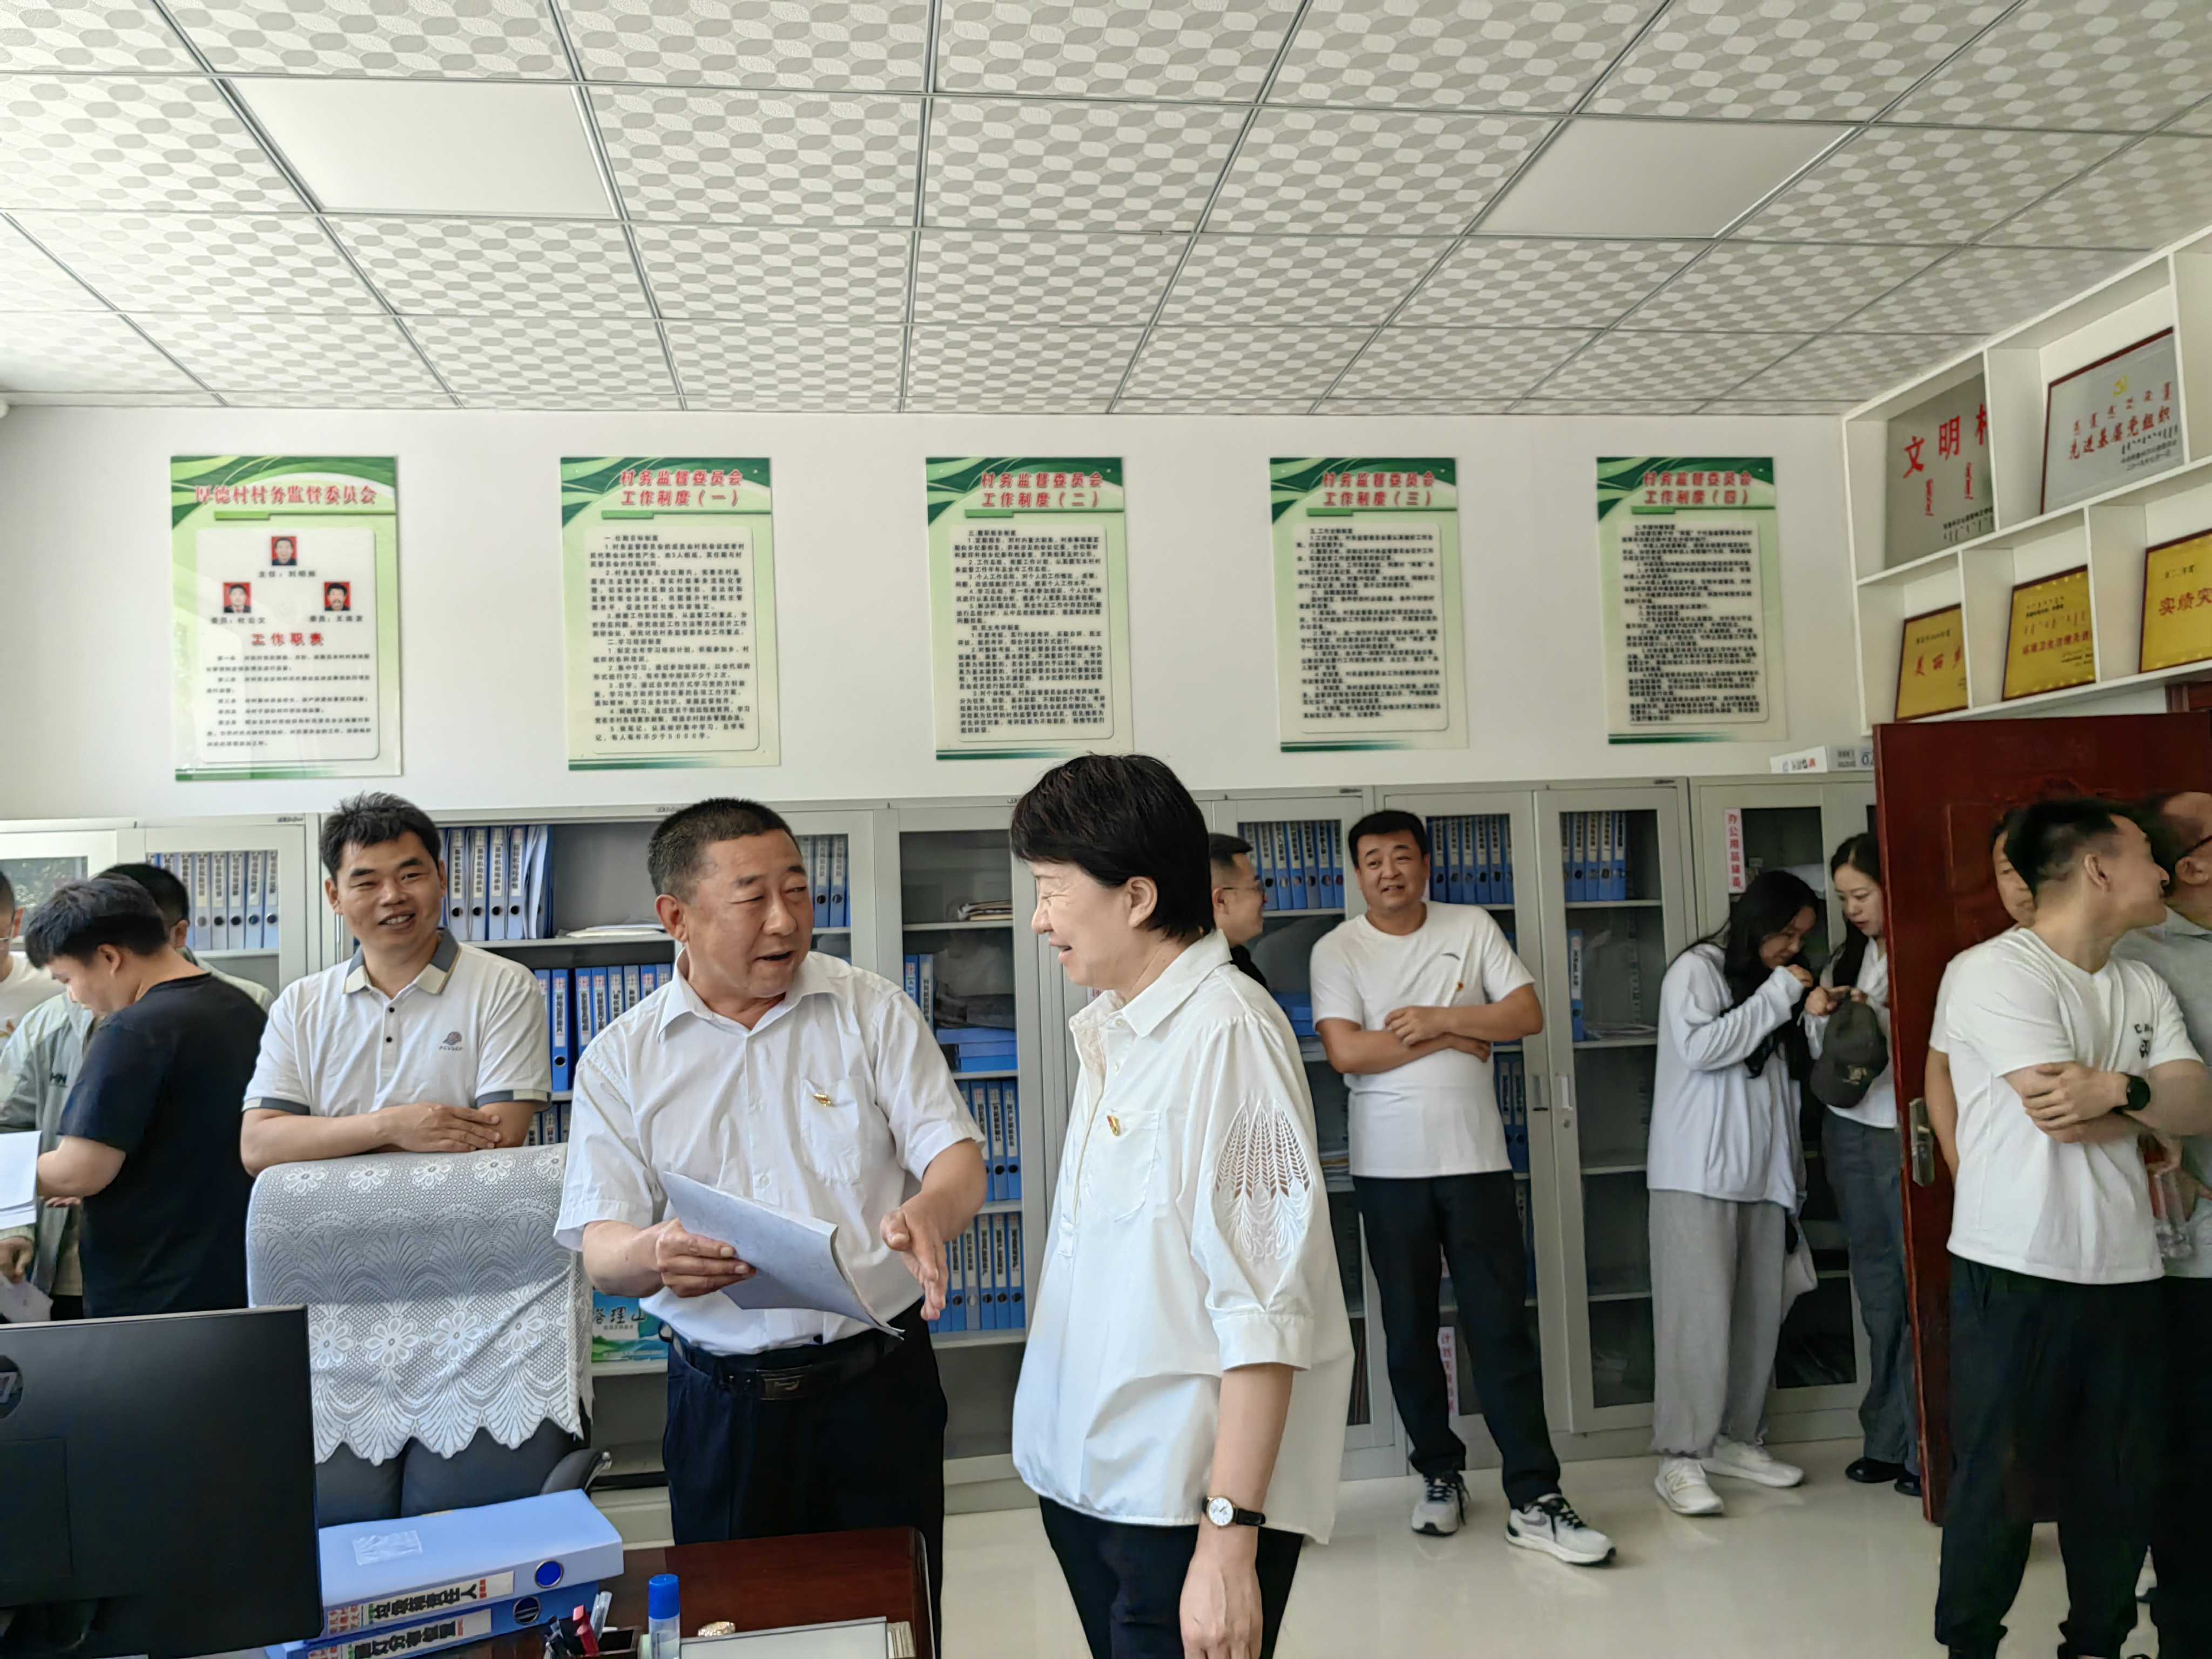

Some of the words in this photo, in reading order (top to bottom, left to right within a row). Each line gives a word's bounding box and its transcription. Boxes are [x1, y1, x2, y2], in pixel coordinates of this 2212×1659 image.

[2069, 406, 2170, 460] 先进基层党组织
[619, 469, 744, 485] 村务监督委员会
[980, 472, 1103, 488] 村务监督委员会
[1322, 472, 1435, 488] 村务监督委员会
[1643, 471, 1751, 486] 村务监督委员会
[194, 484, 377, 505] 厚德村村务监督委员会
[251, 633, 323, 646] 工作职责
